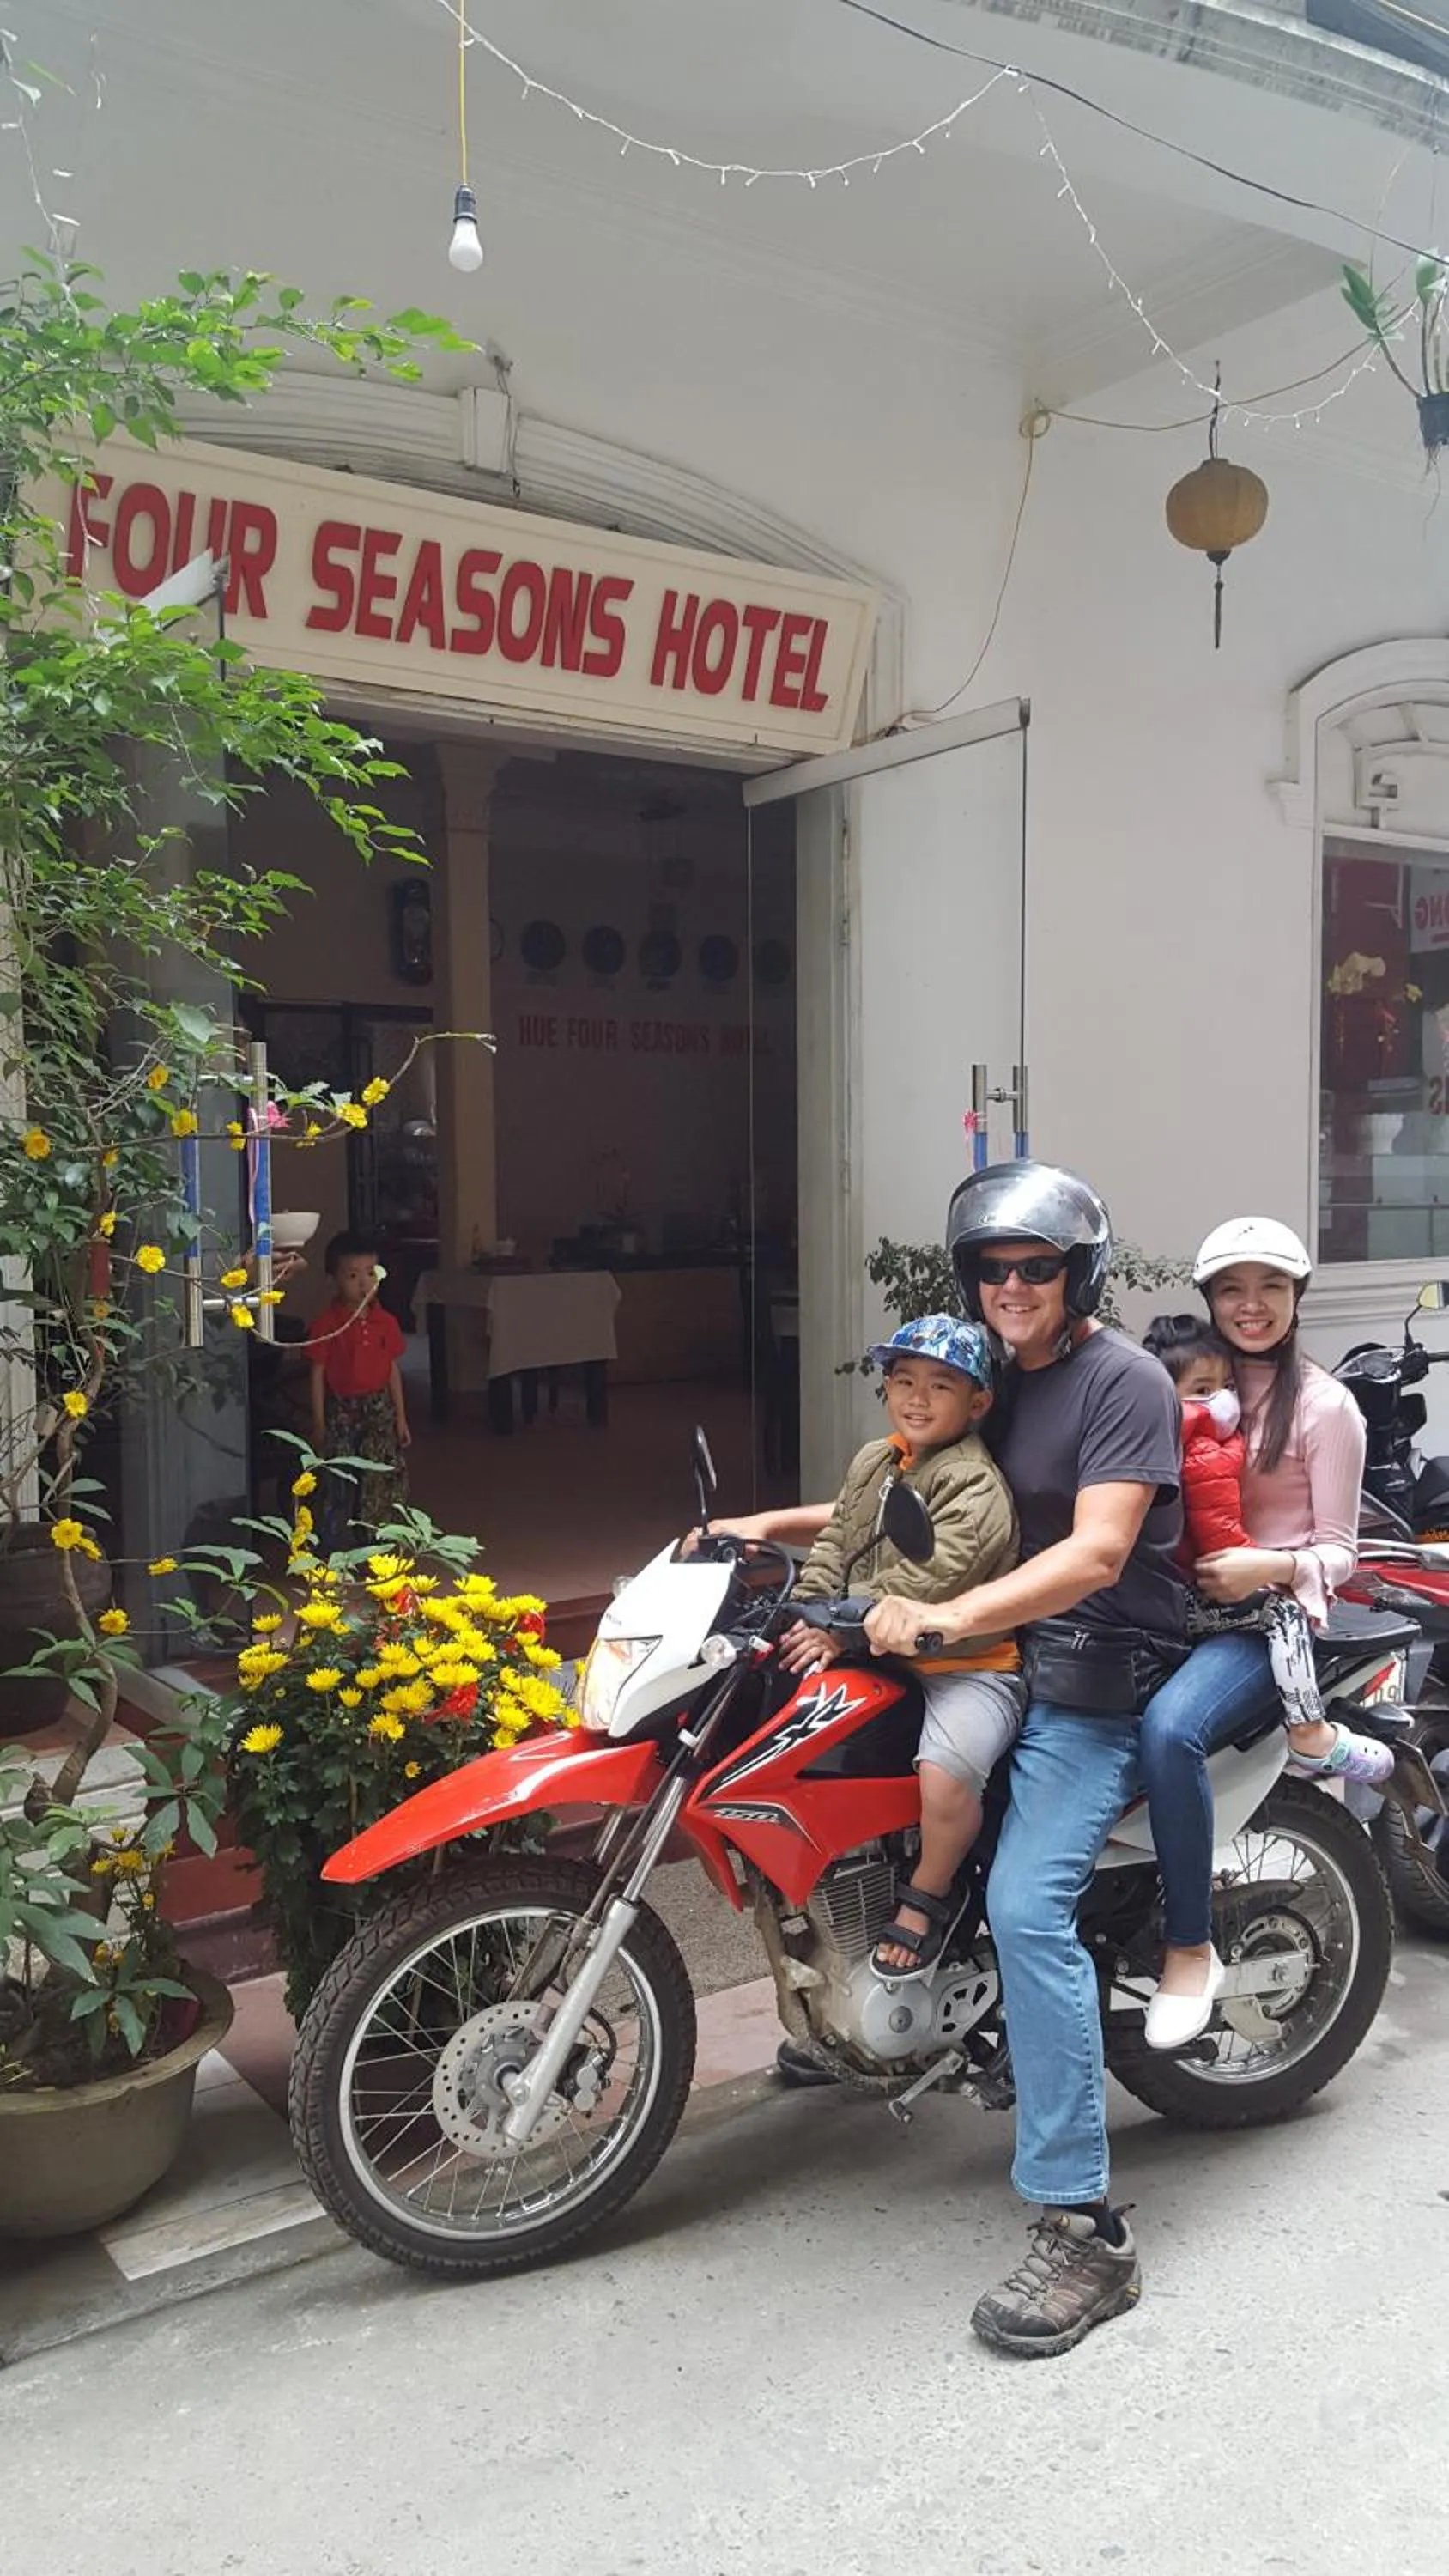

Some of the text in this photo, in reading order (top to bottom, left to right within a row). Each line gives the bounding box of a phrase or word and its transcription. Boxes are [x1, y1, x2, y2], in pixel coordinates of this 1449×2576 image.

[66, 471, 829, 713] FOUR SEASONS HOTEL
[518, 1015, 558, 1048] HUE
[567, 1017, 618, 1052] FOUR
